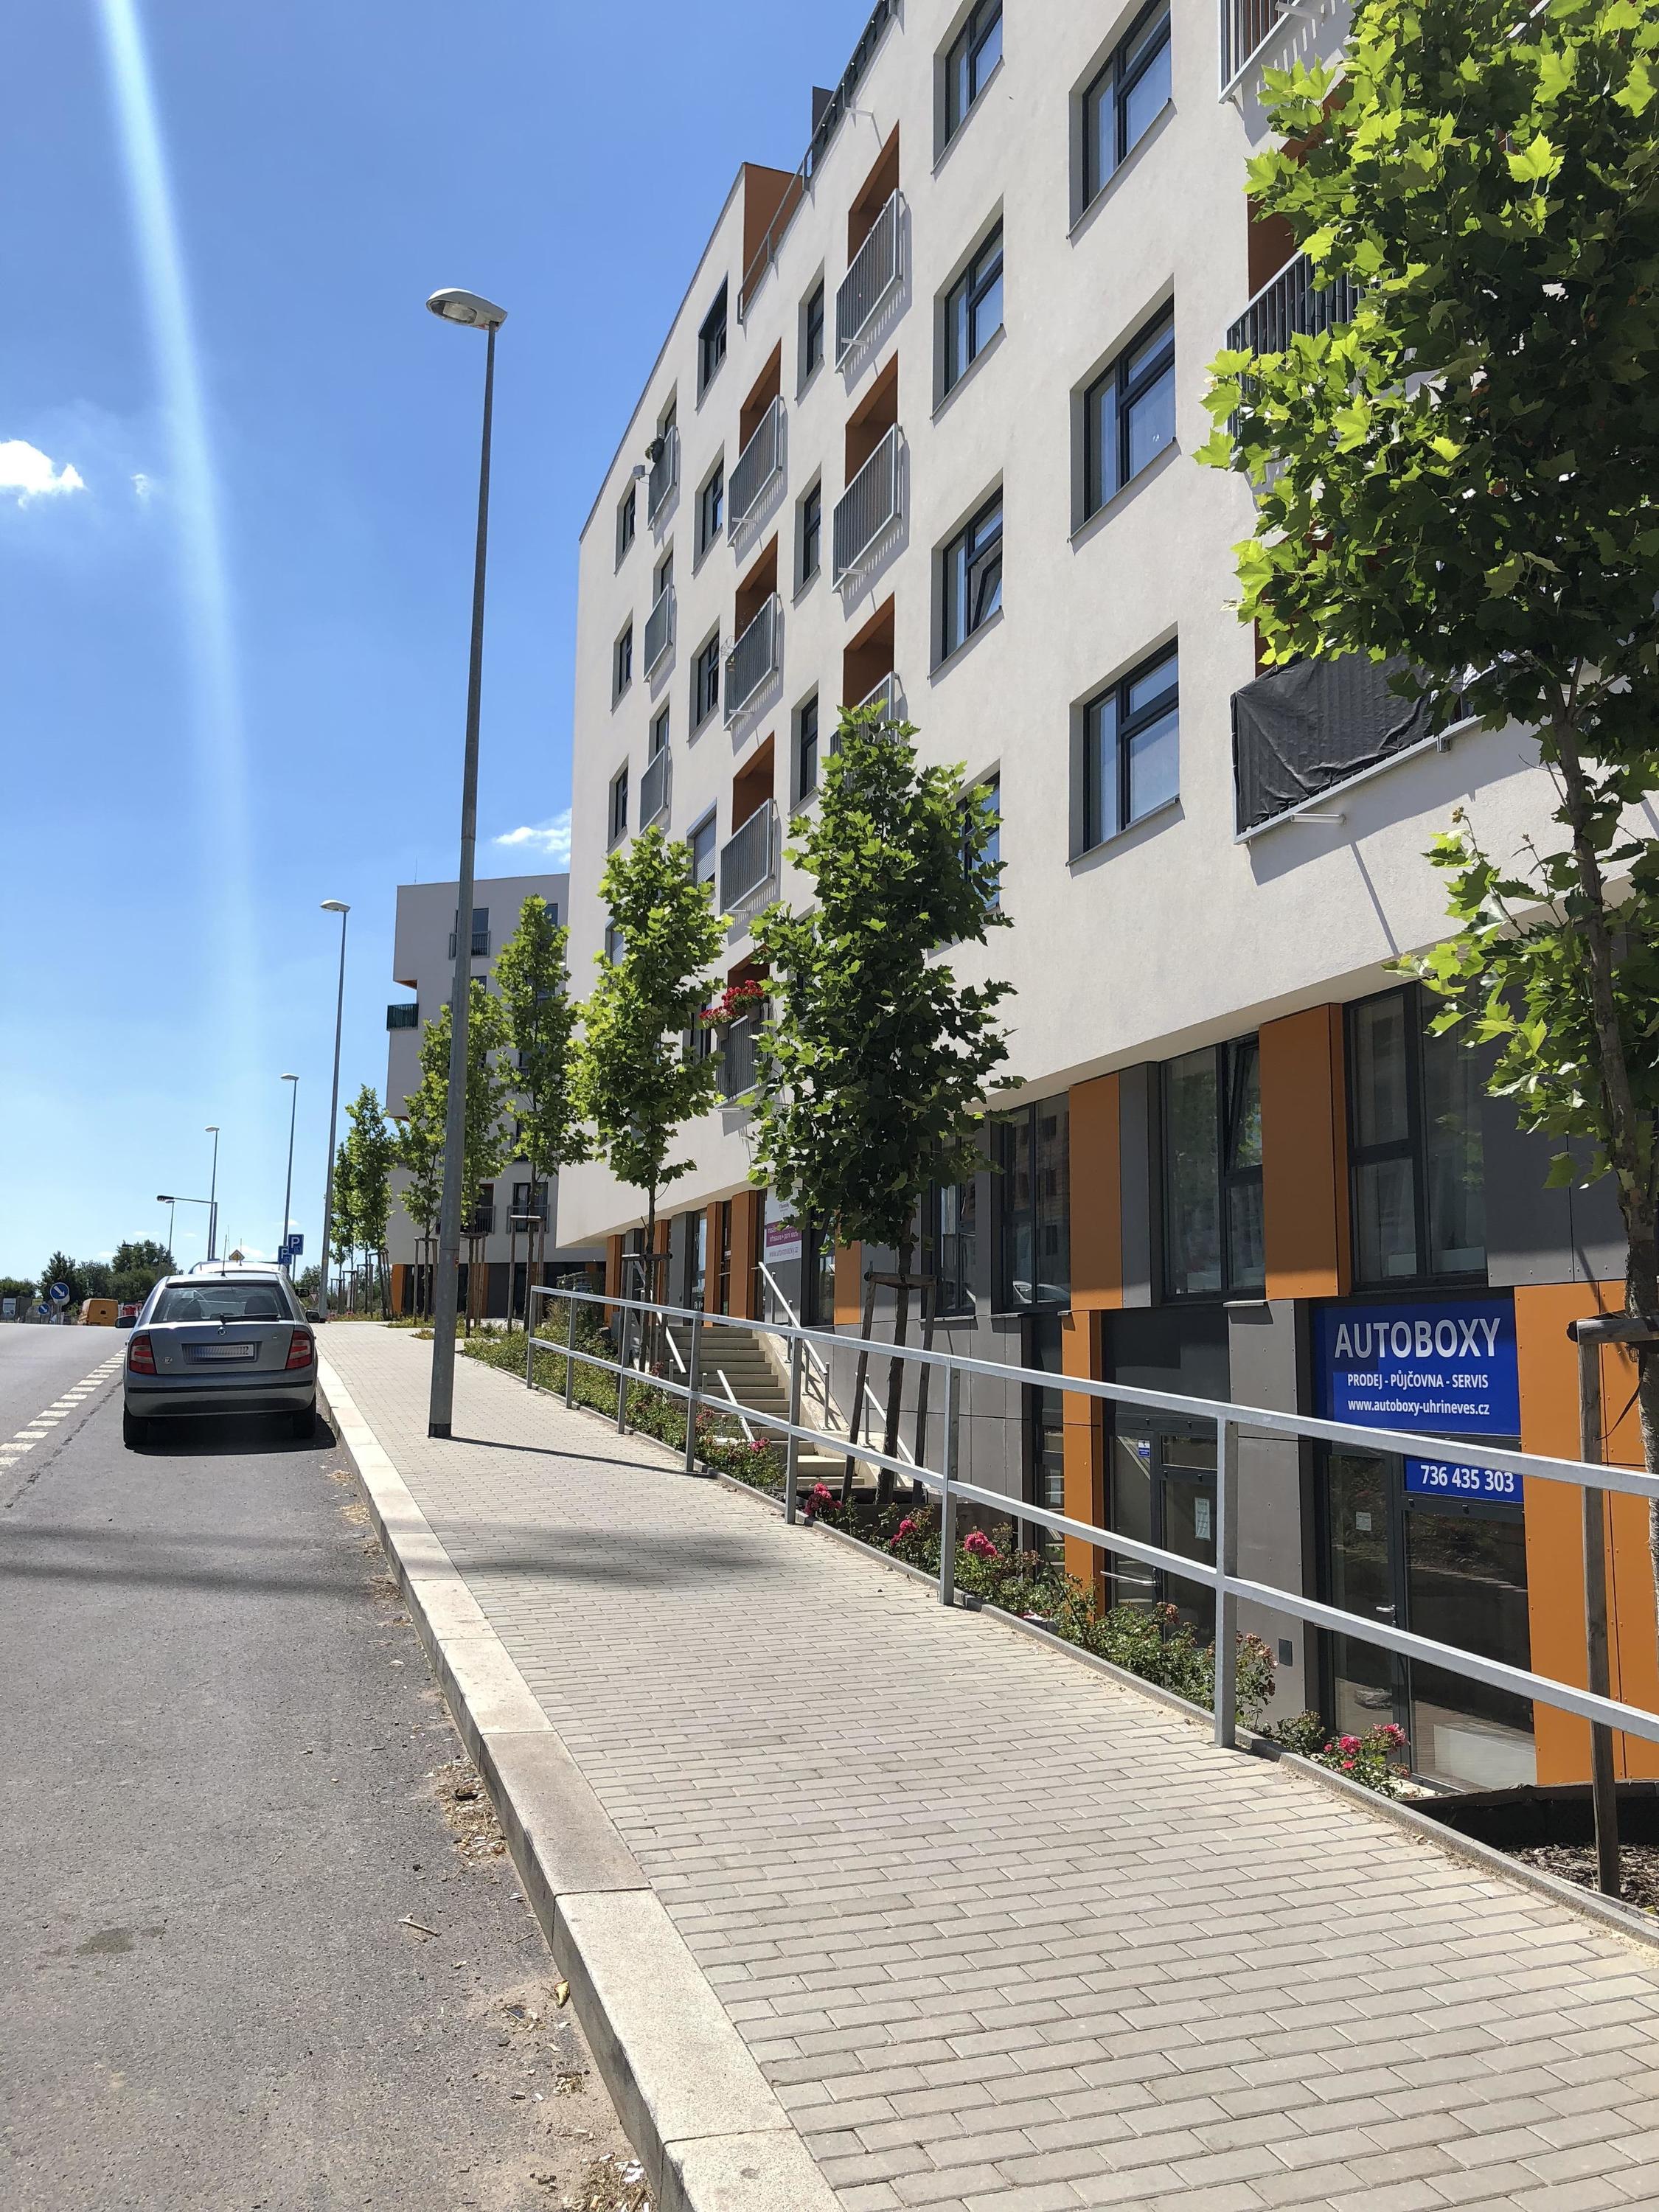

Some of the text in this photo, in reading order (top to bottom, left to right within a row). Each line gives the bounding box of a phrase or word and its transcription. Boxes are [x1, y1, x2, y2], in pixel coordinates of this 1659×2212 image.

[291, 1237, 300, 1248] P
[281, 1248, 289, 1259] P
[1334, 1318, 1500, 1359] AUTOBOXY
[1347, 1374, 1383, 1390] PRODEJ
[1390, 1369, 1444, 1391] PŮJČOVNA
[1452, 1374, 1489, 1388] SERVIS
[1348, 1398, 1490, 1416] www.autoboxy-uhrineves.cz
[1420, 1464, 1514, 1493] 736 435 303
